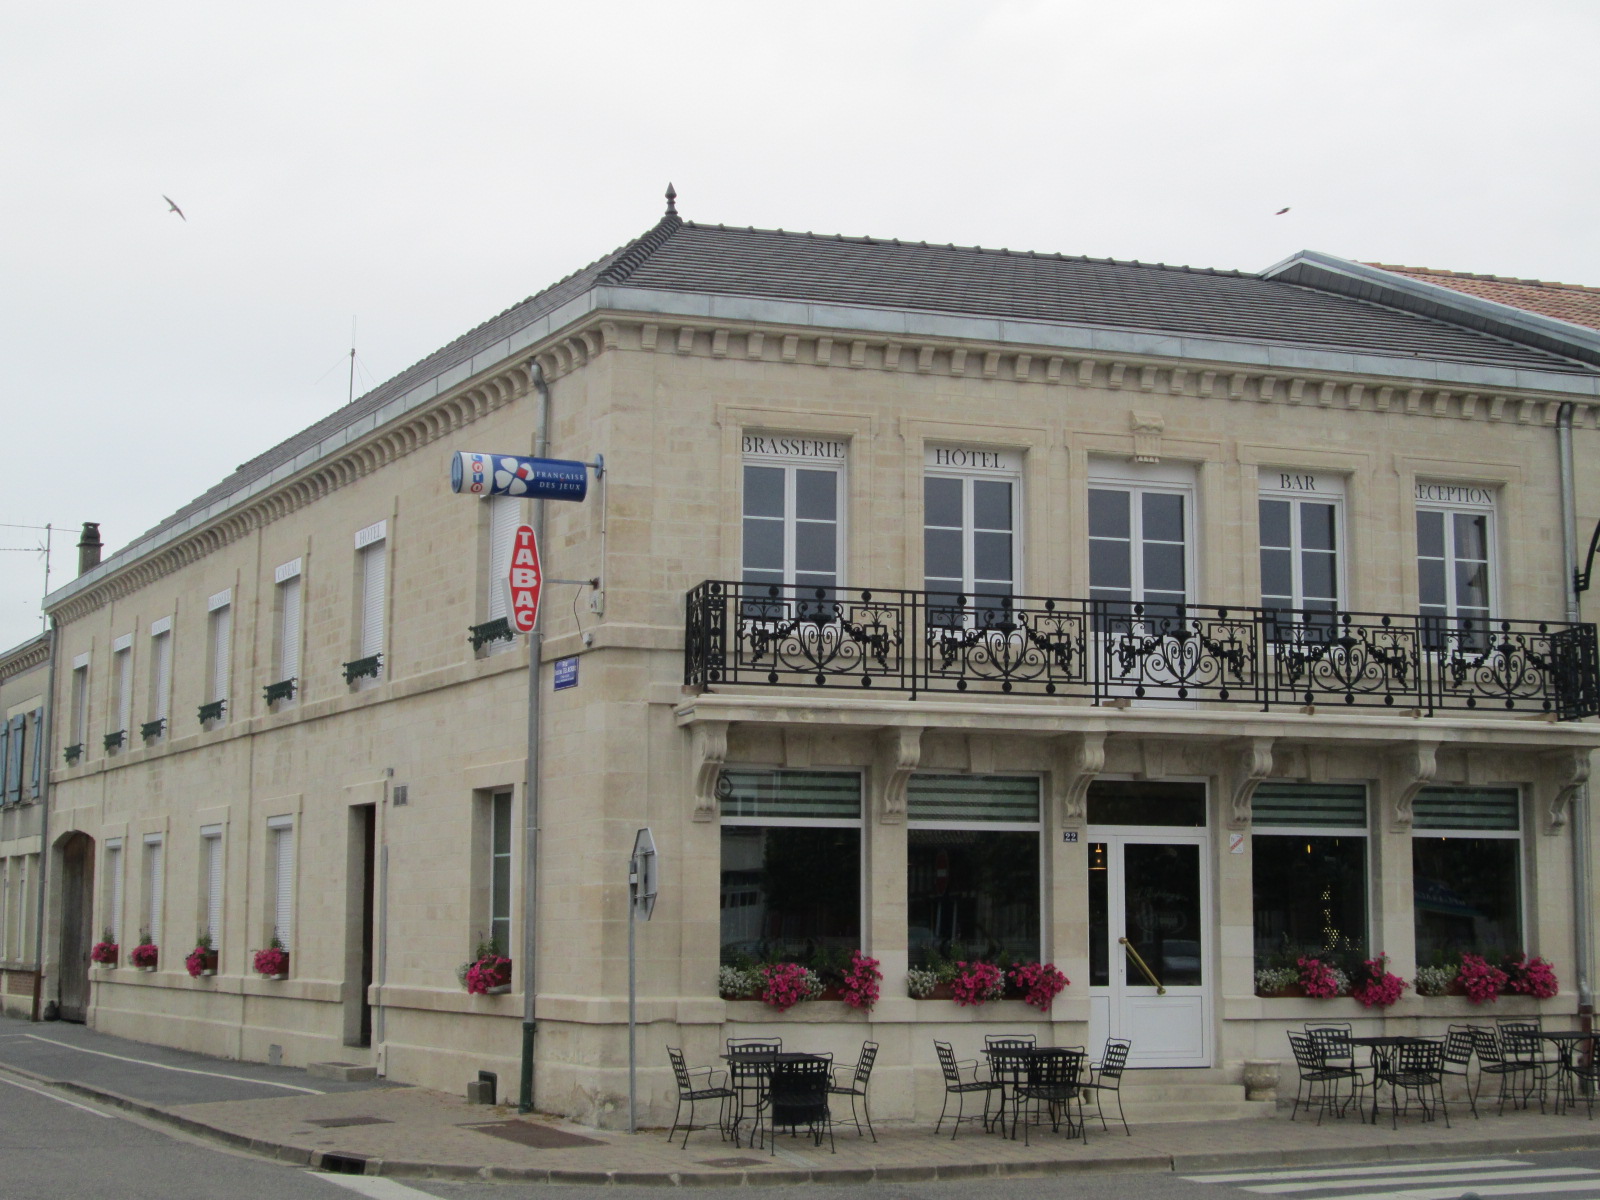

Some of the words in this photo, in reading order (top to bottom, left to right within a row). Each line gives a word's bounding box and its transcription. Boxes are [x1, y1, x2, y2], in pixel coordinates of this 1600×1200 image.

[742, 436, 844, 458] BRASSERIE
[936, 448, 1005, 468] HÔTEL
[470, 454, 484, 493] LOTO
[536, 471, 584, 481] FRANÇAISE
[1280, 473, 1316, 491] BAR
[539, 481, 555, 489] DES
[559, 482, 581, 491] JEUX
[512, 531, 537, 625] TABAC
[1065, 832, 1076, 842] 22
